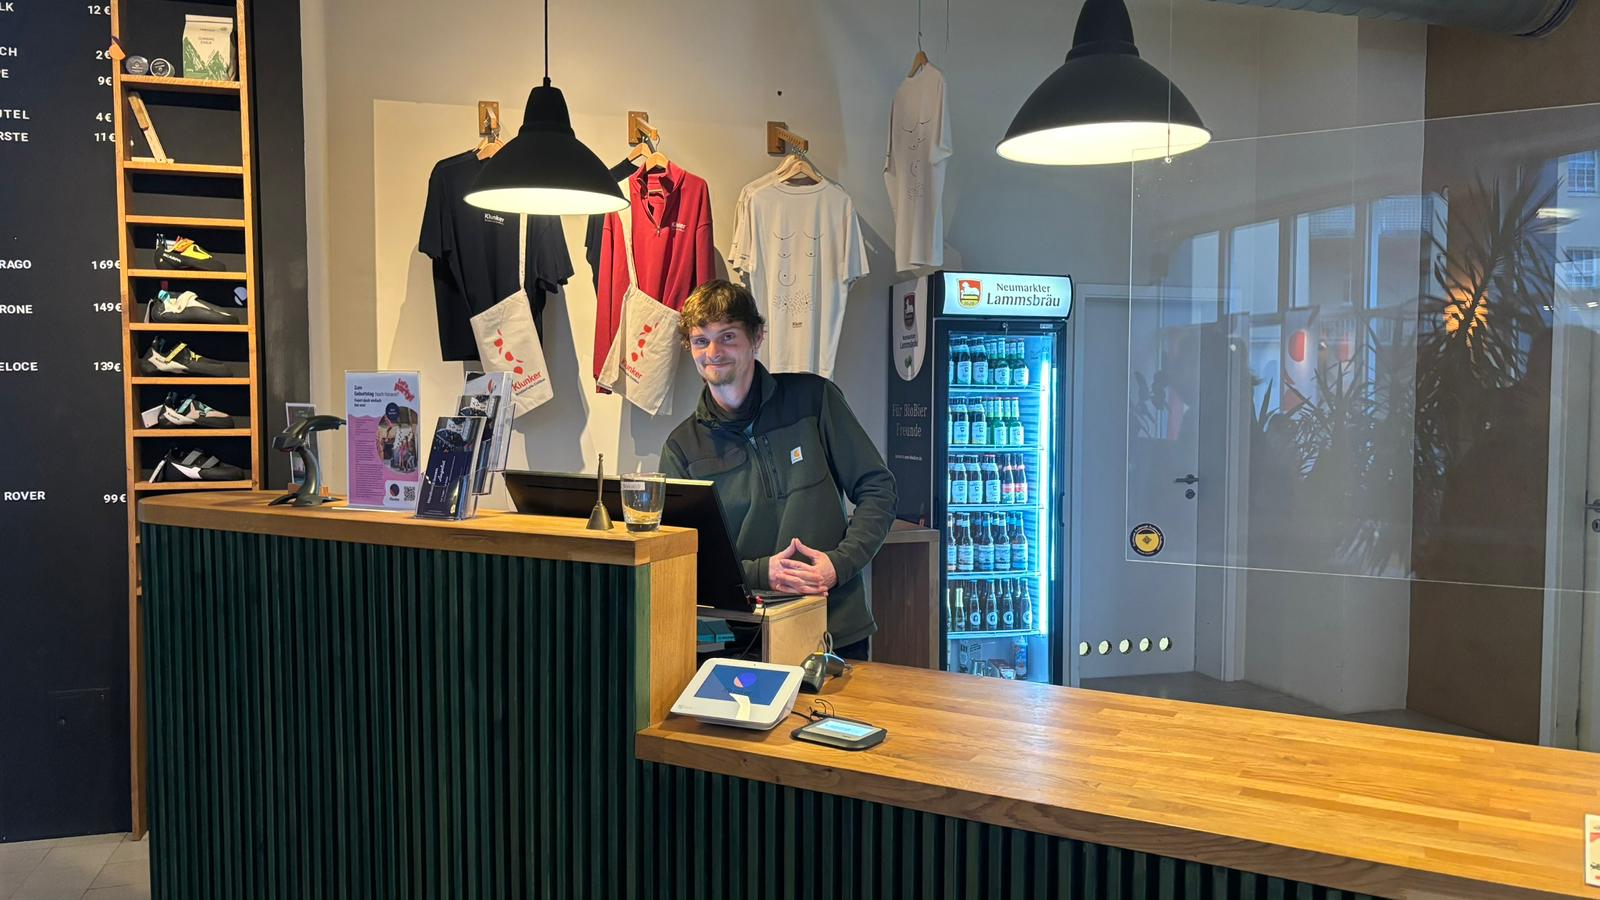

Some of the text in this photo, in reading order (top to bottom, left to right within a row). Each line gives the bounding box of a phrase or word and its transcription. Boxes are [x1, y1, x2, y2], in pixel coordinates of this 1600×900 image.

[0, 46, 18, 57] CH
[96, 112, 112, 122] 4€
[0, 259, 32, 269] RAGO
[996, 282, 1051, 293] Neumarkter
[987, 292, 1061, 307] Lammsbräu
[0, 304, 33, 314] RONE
[93, 361, 121, 373] 139€
[512, 370, 542, 391] Klunker
[4, 491, 46, 501] ROVER
